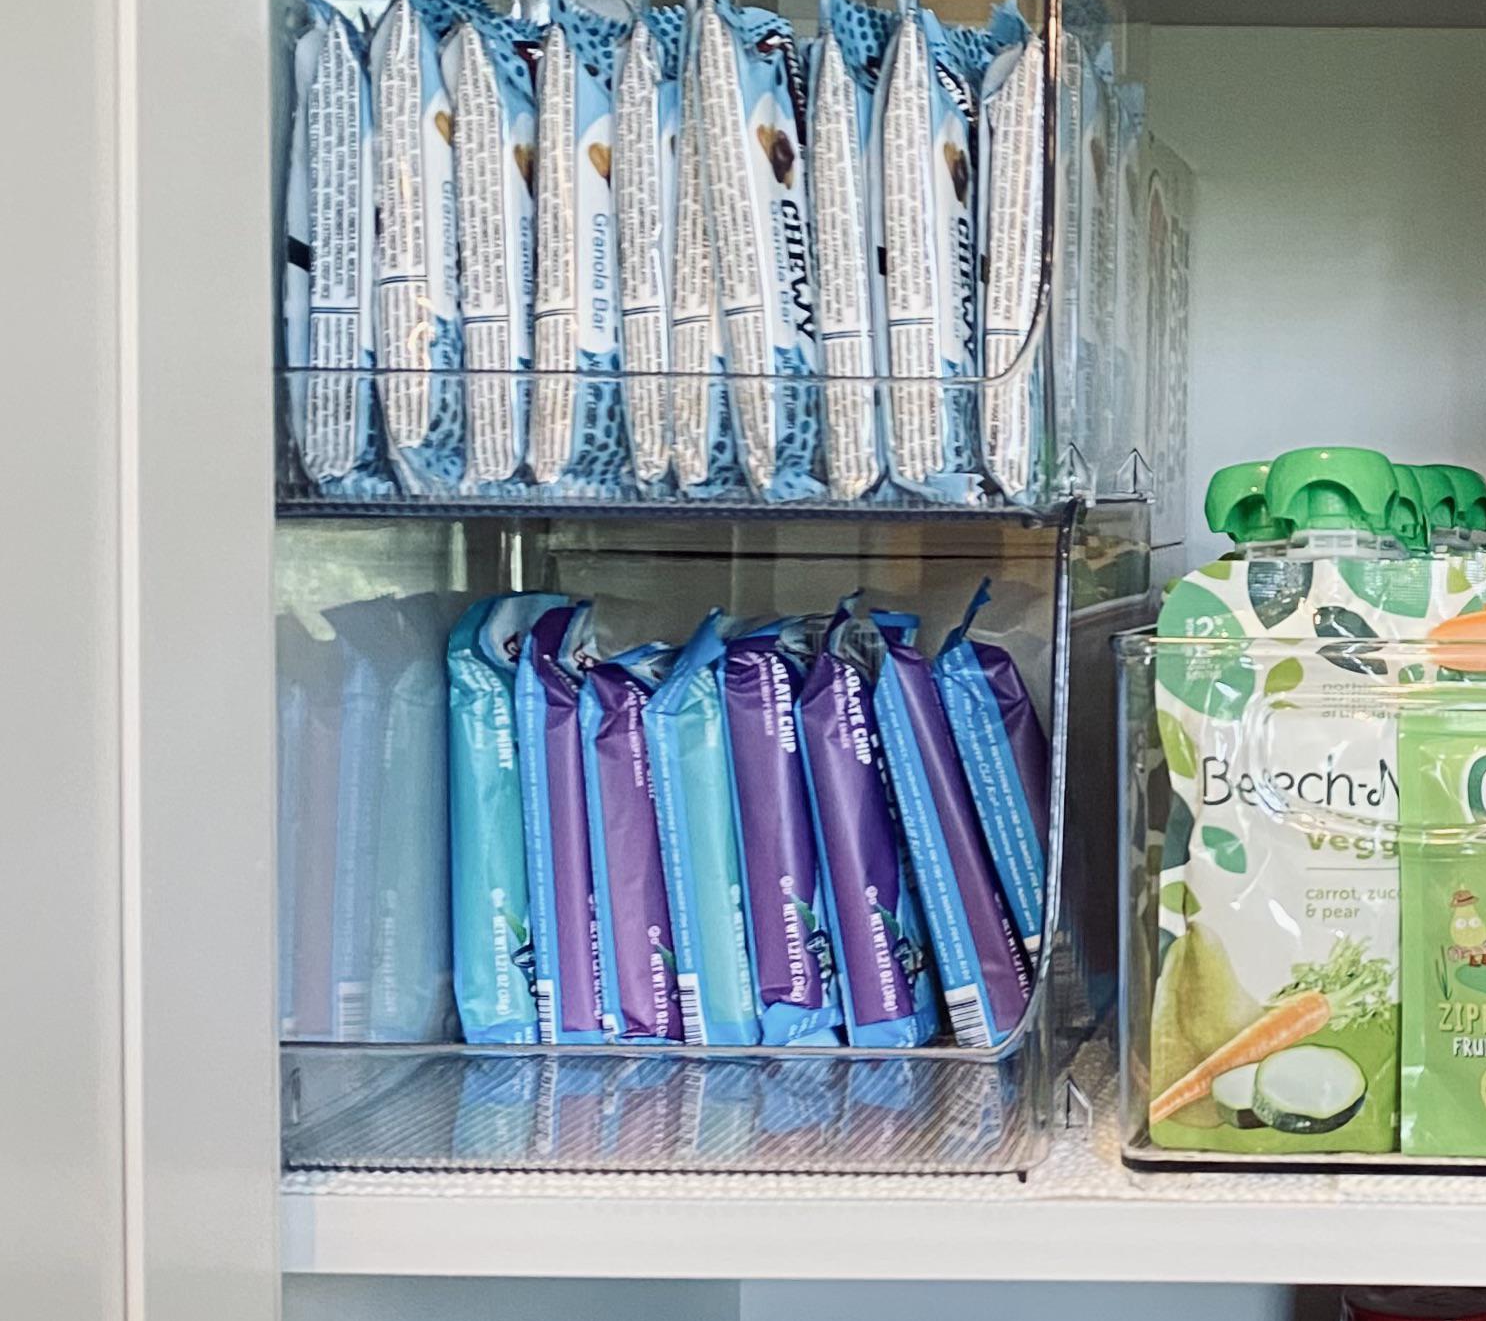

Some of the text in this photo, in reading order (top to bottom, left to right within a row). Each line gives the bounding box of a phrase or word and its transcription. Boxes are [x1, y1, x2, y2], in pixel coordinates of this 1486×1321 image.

[592, 214, 609, 333] Granola Bar
[781, 199, 816, 342] CHEWY
[778, 717, 796, 753] CHIP
[853, 728, 872, 765] CHIP
[498, 728, 514, 771] MINT
[782, 903, 797, 922] NET
[1306, 904, 1360, 921] & pear
[785, 924, 798, 939] WT
[787, 941, 801, 961] 1.27
[789, 963, 803, 975] OZ
